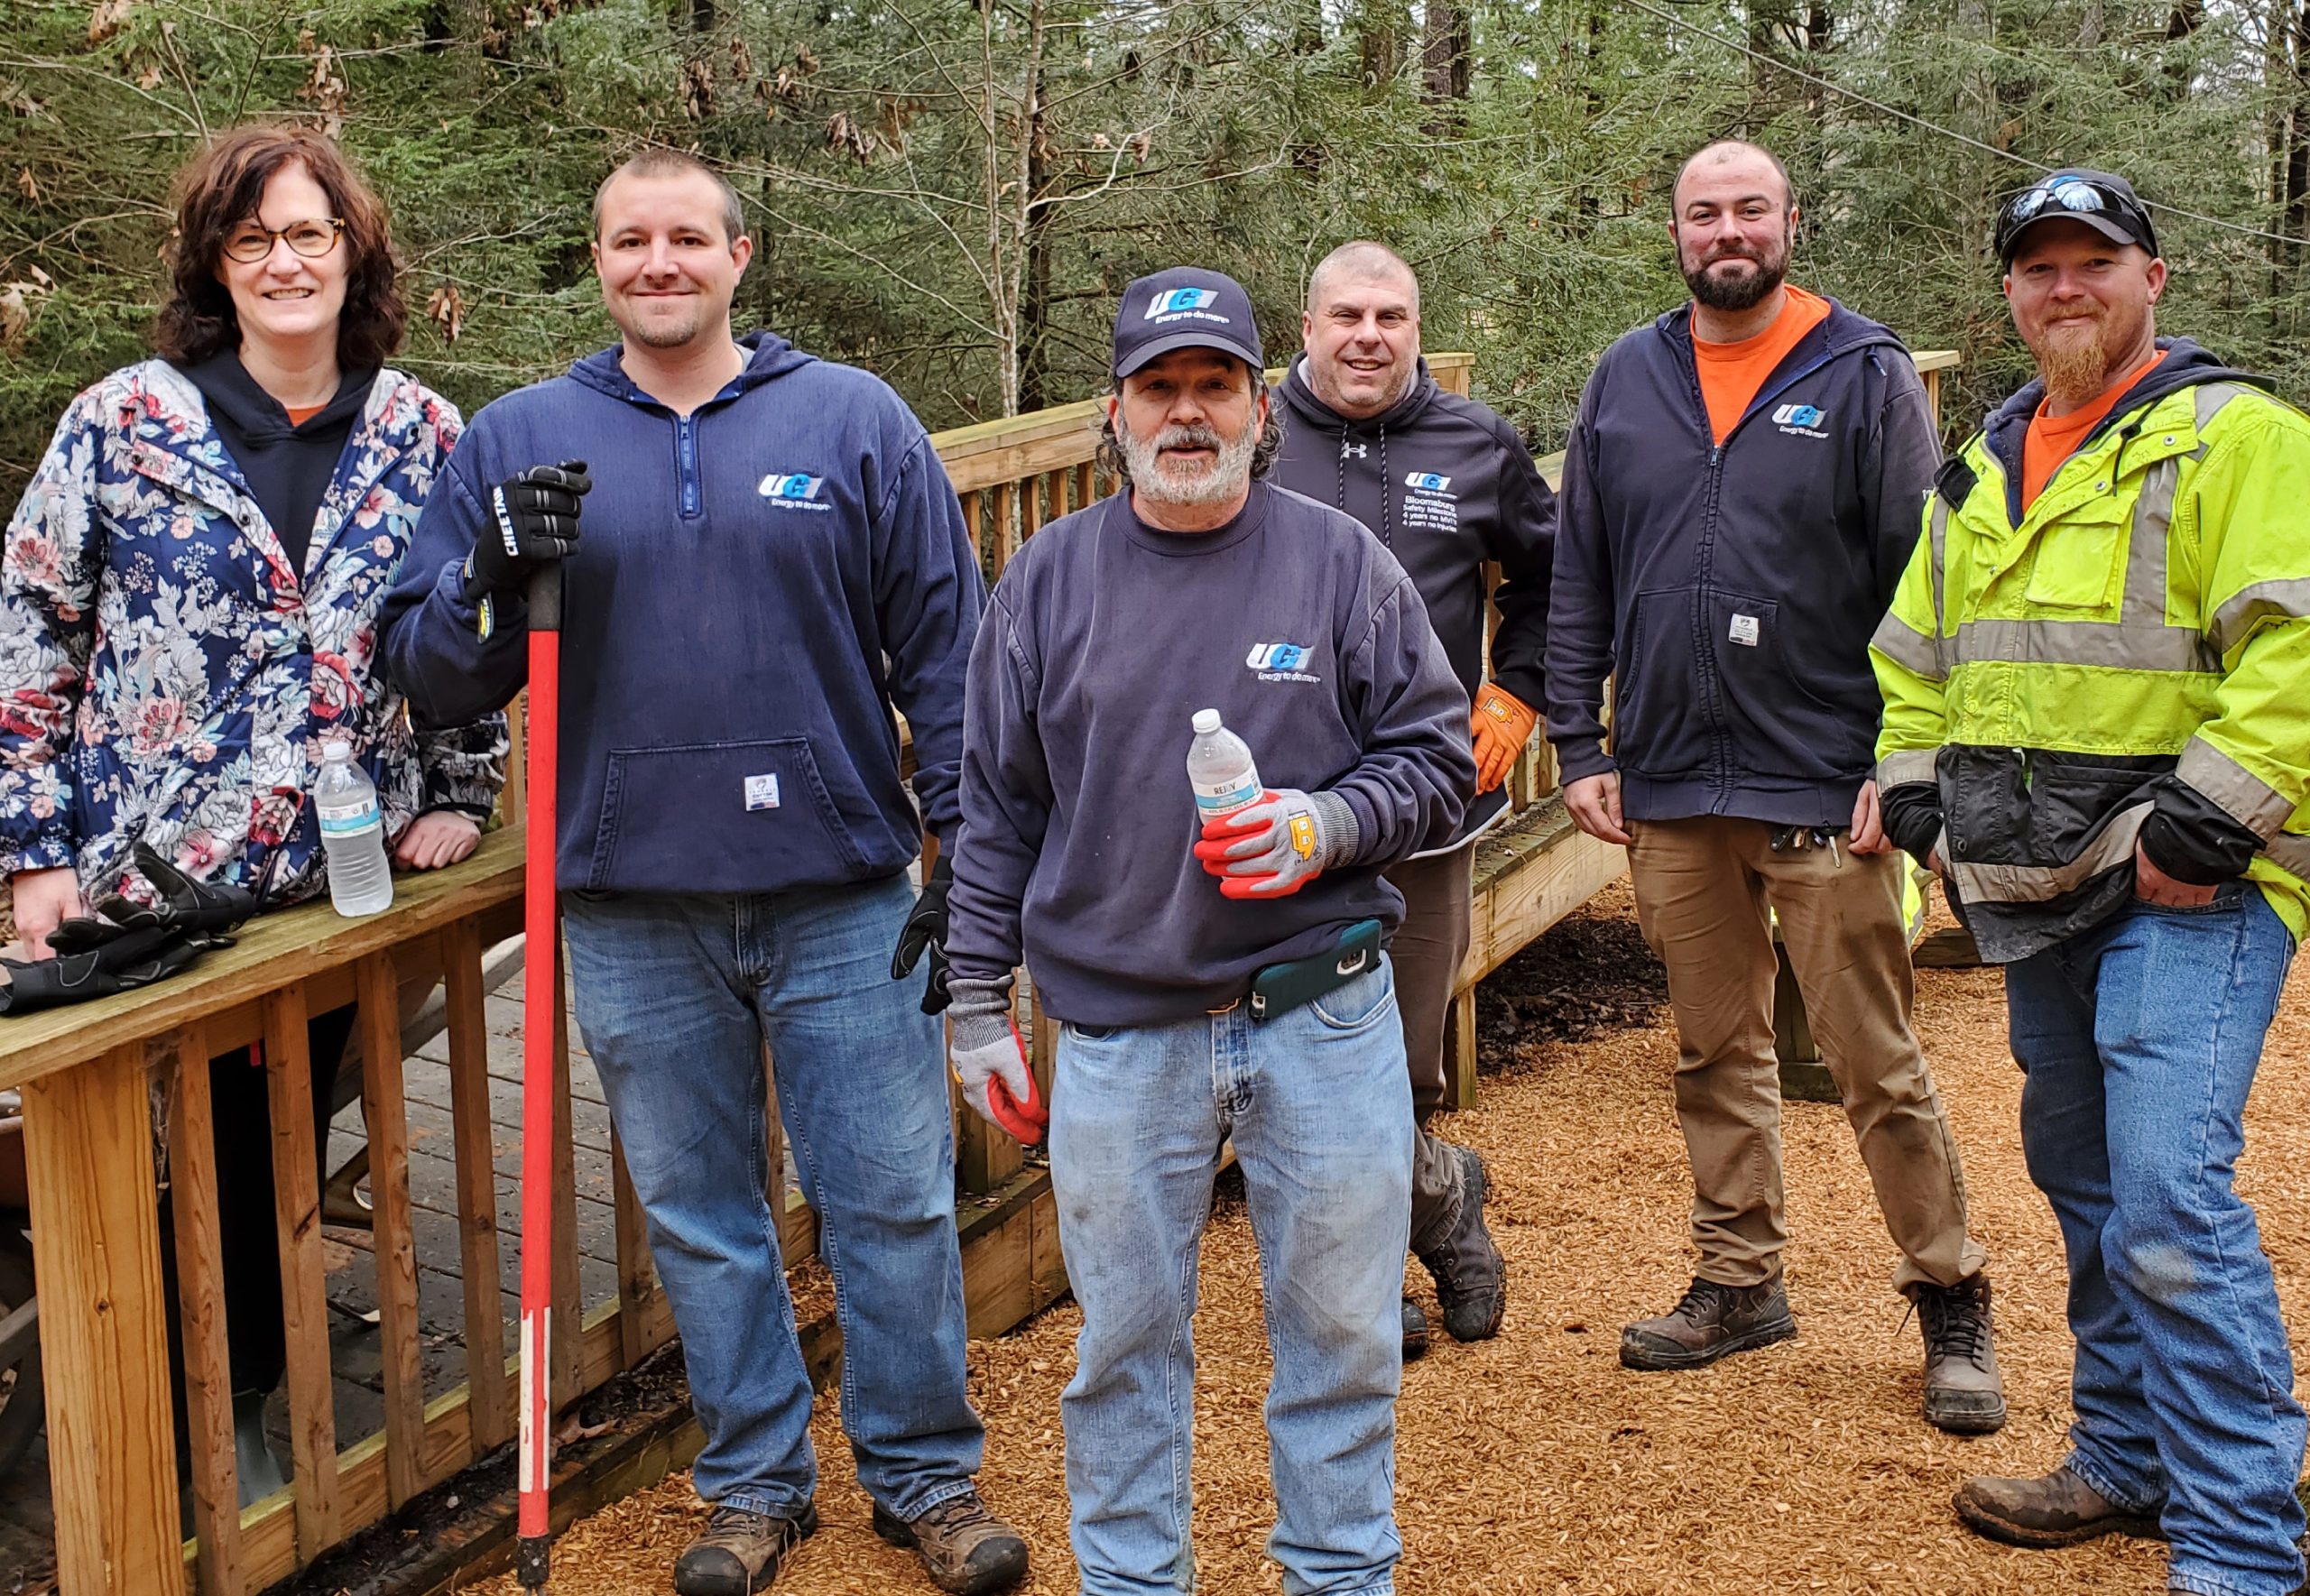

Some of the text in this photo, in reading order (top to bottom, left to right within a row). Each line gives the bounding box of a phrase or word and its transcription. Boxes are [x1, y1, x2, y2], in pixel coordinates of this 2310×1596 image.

[1143, 287, 1219, 320] UGI
[1155, 312, 1183, 325] Energy
[1193, 310, 1205, 318] do
[1771, 403, 1828, 429] UGI
[758, 473, 824, 499] UGI
[1404, 472, 1451, 491] UGI
[772, 498, 794, 509] Energy
[795, 500, 803, 508] to
[803, 501, 811, 509] do
[1402, 503, 1457, 519] Safety Milestone
[1246, 642, 1315, 669] UGI
[1257, 671, 1282, 682] Energy
[1282, 671, 1290, 679] to
[1291, 671, 1301, 681] do
